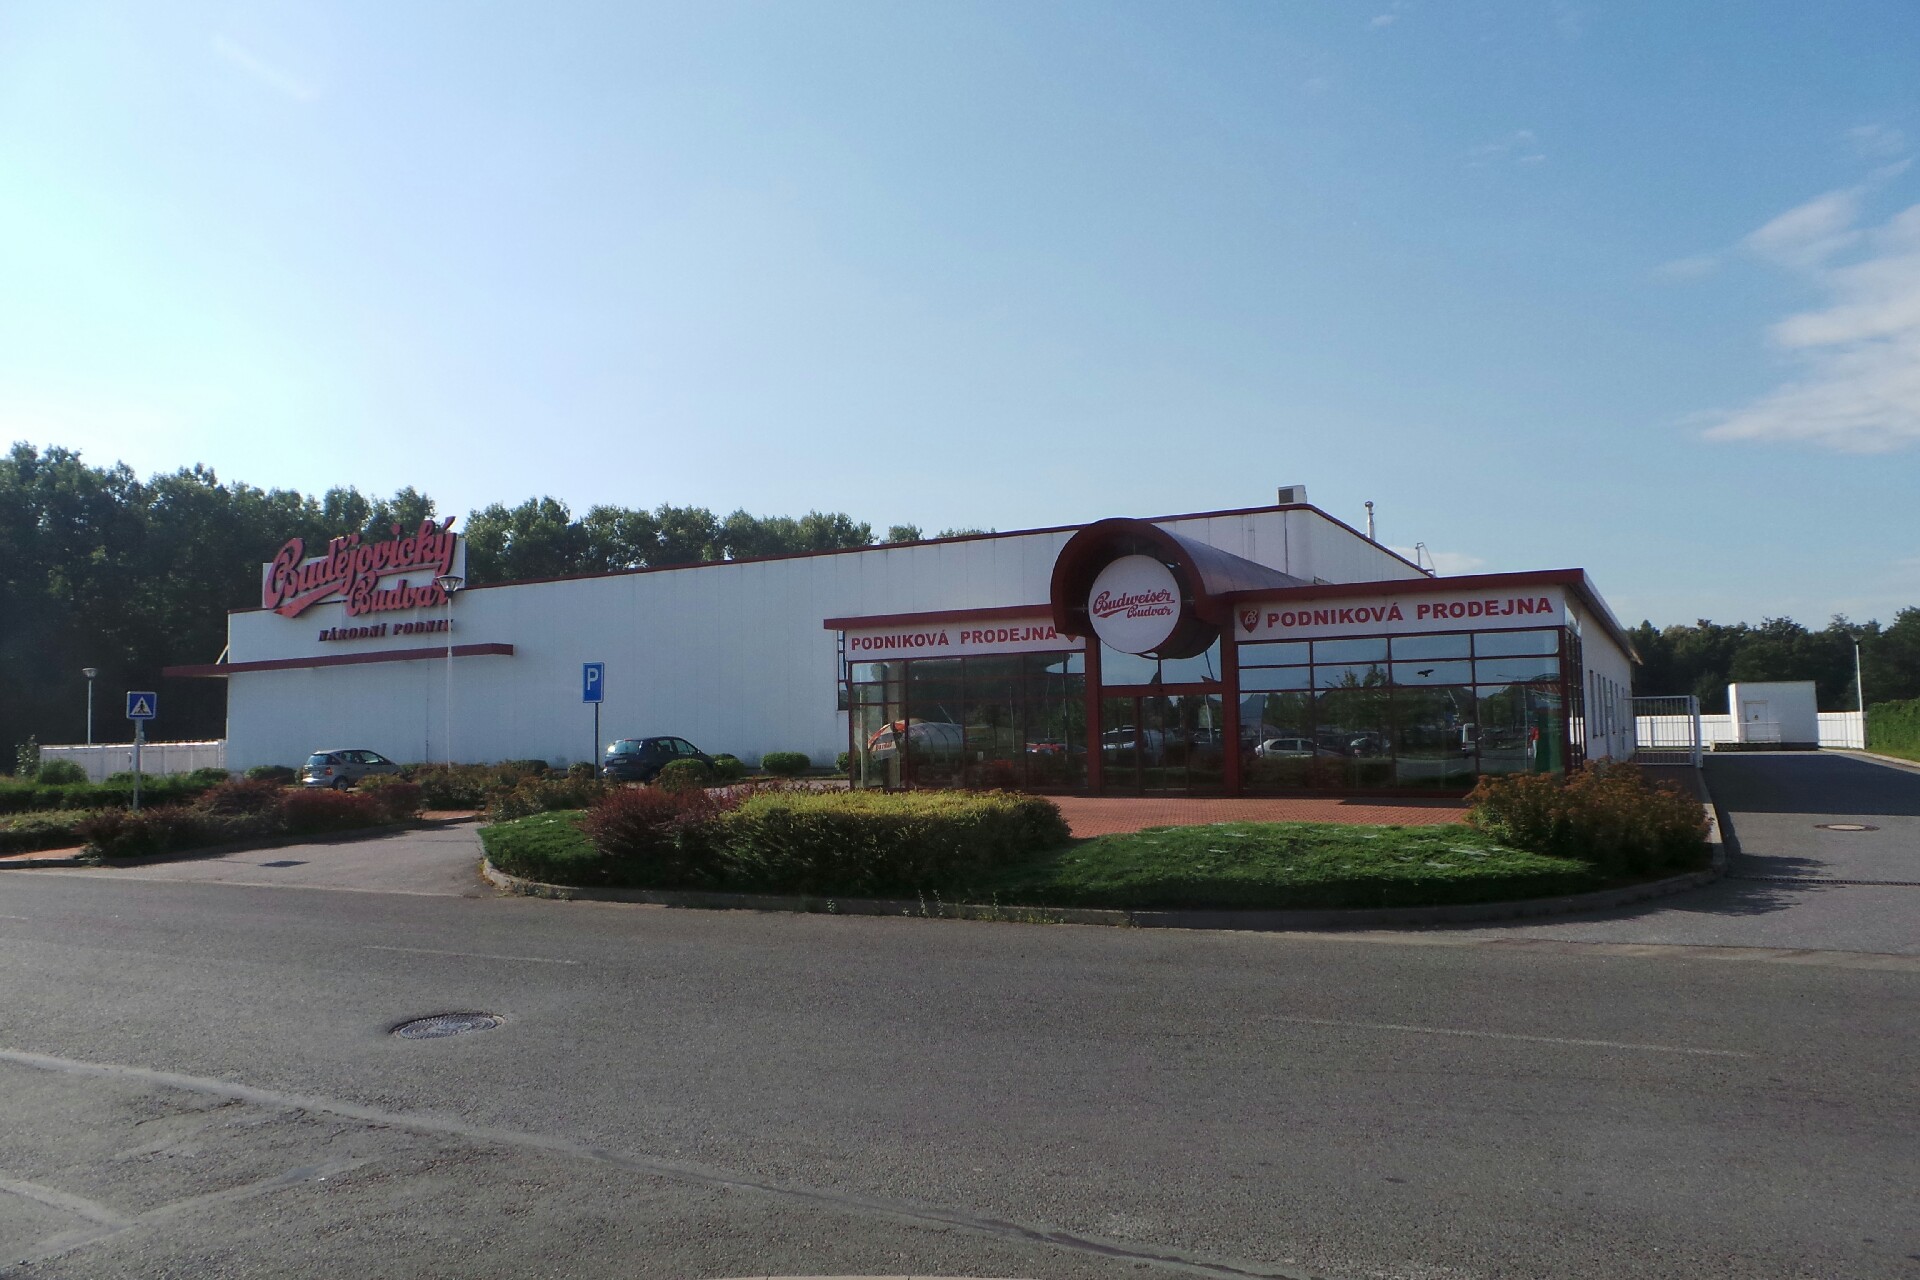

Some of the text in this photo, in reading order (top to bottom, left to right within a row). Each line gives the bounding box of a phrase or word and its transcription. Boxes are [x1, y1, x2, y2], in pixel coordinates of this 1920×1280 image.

[264, 516, 457, 617] Budějovický
[346, 571, 450, 616] Budvar
[1093, 589, 1175, 618] Budweiser
[1127, 604, 1173, 619] Budvar
[1267, 598, 1553, 628] PODNIKOVÁ PRODEJNA
[318, 623, 387, 642] NÁRODNÍ
[852, 626, 1057, 650] PODNIKOVÁ PRODEJNA
[587, 667, 599, 691] P
